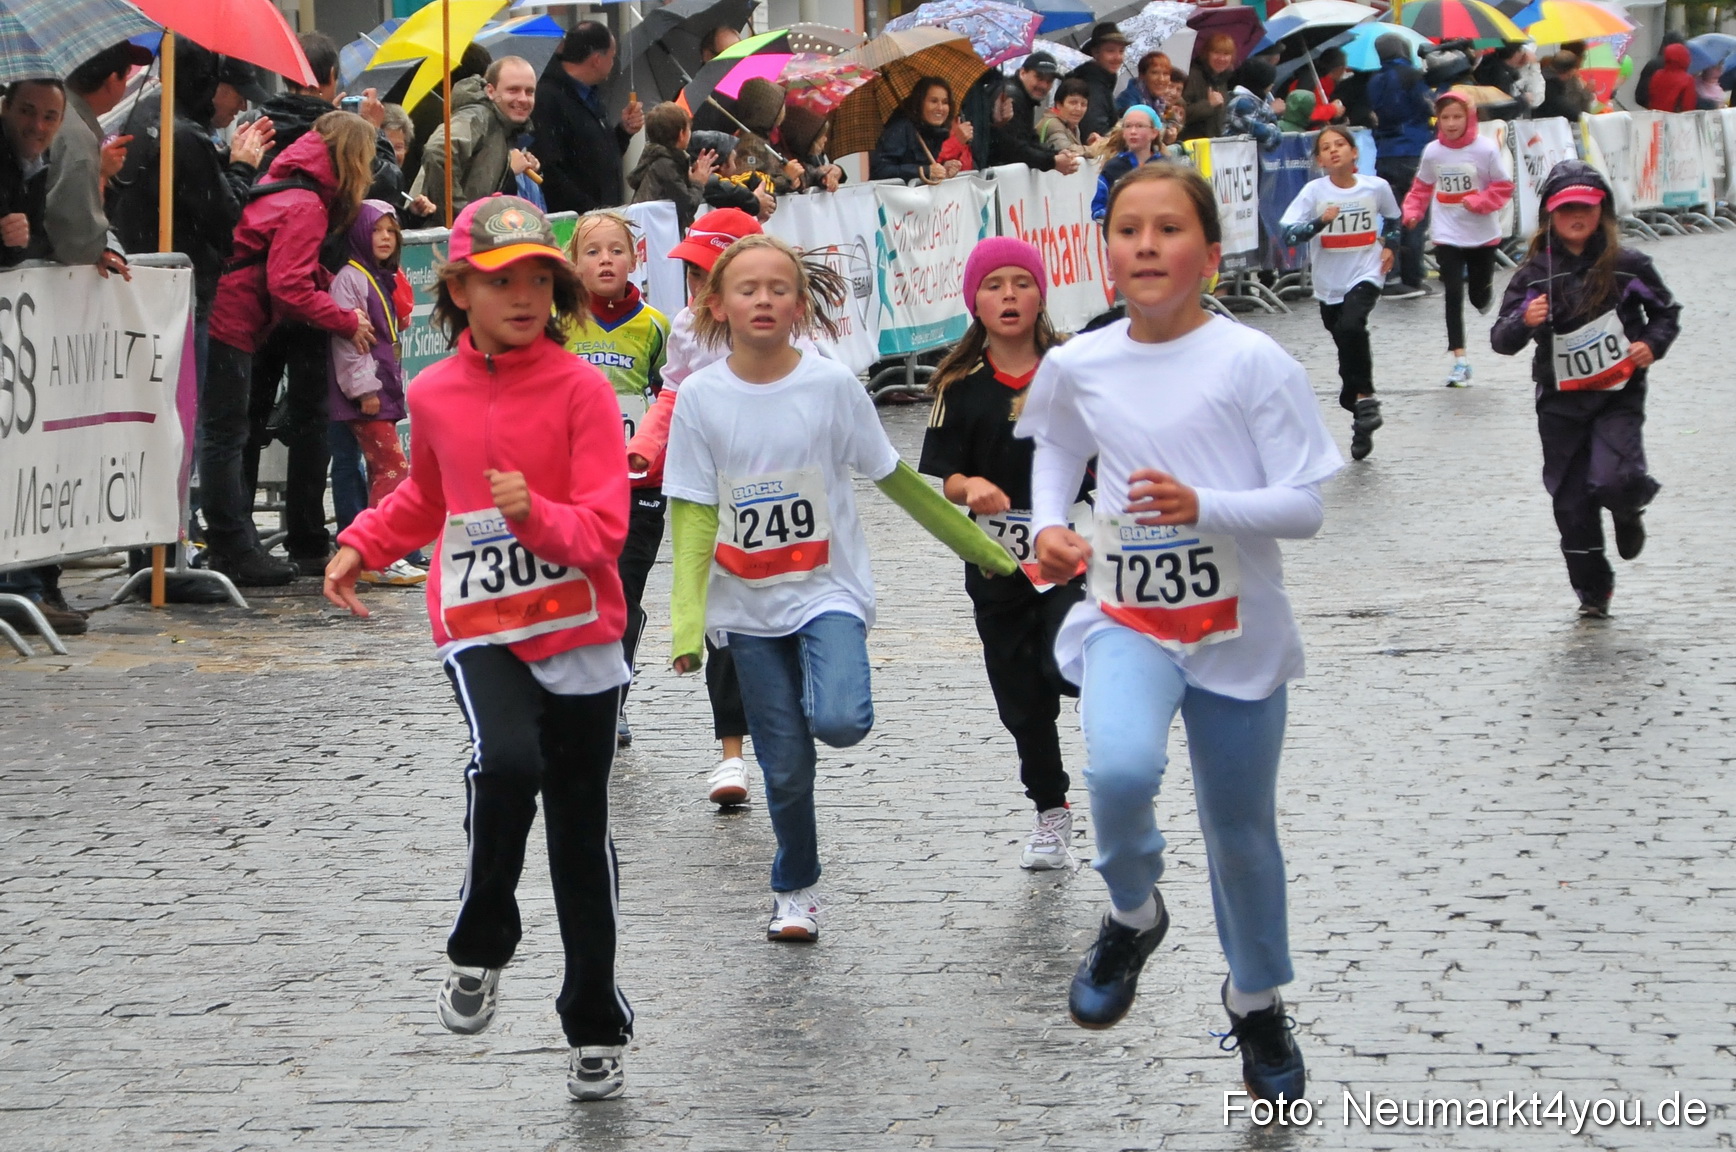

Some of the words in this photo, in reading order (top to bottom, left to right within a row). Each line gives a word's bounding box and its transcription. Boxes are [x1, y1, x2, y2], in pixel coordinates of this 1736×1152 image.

[574, 341, 615, 352] TEAM
[1557, 334, 1622, 377] 7079
[732, 481, 784, 501] BOCK
[465, 517, 513, 538] BOC
[1120, 526, 1179, 541] BOCK
[1106, 545, 1220, 605] 7235
